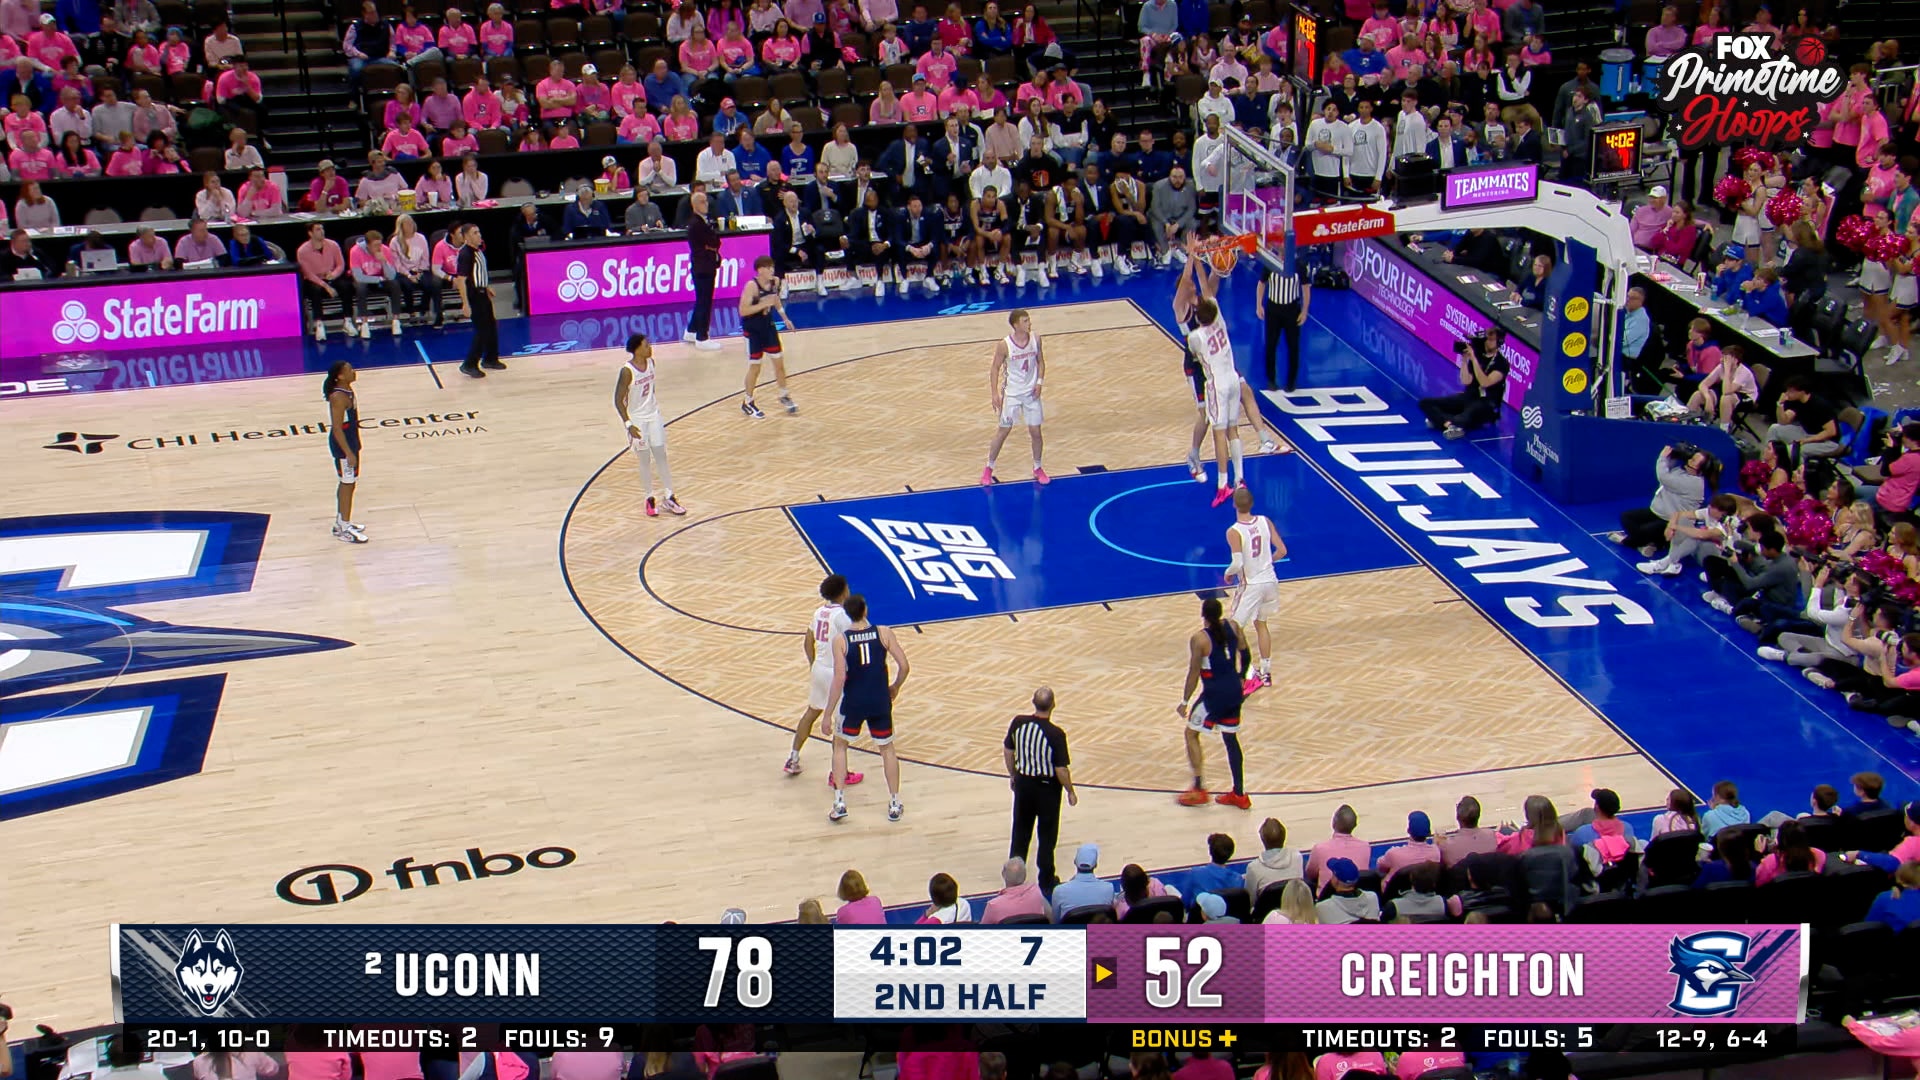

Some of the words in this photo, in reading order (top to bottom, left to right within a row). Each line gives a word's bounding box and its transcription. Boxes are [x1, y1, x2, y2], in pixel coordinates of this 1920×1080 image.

[1606, 132, 1635, 148] 4:02
[1455, 172, 1529, 199] TEAMMATES
[1365, 246, 1399, 293] FOUR
[1400, 271, 1433, 314] LEAF
[938, 301, 995, 316] 45
[1207, 328, 1228, 356] 32
[1021, 359, 1029, 373] 4
[641, 382, 650, 397] 2
[127, 433, 197, 450] CHI
[210, 421, 335, 443] Health
[355, 409, 480, 430] Center
[402, 425, 487, 440] OMAHA
[1260, 386, 1653, 628] BLUEJAYS
[923, 522, 1017, 580] BIG
[1251, 535, 1262, 558] 9
[871, 518, 979, 602] EAST
[816, 620, 829, 642] 12
[859, 643, 871, 665] 11
[386, 847, 577, 890] fnbo
